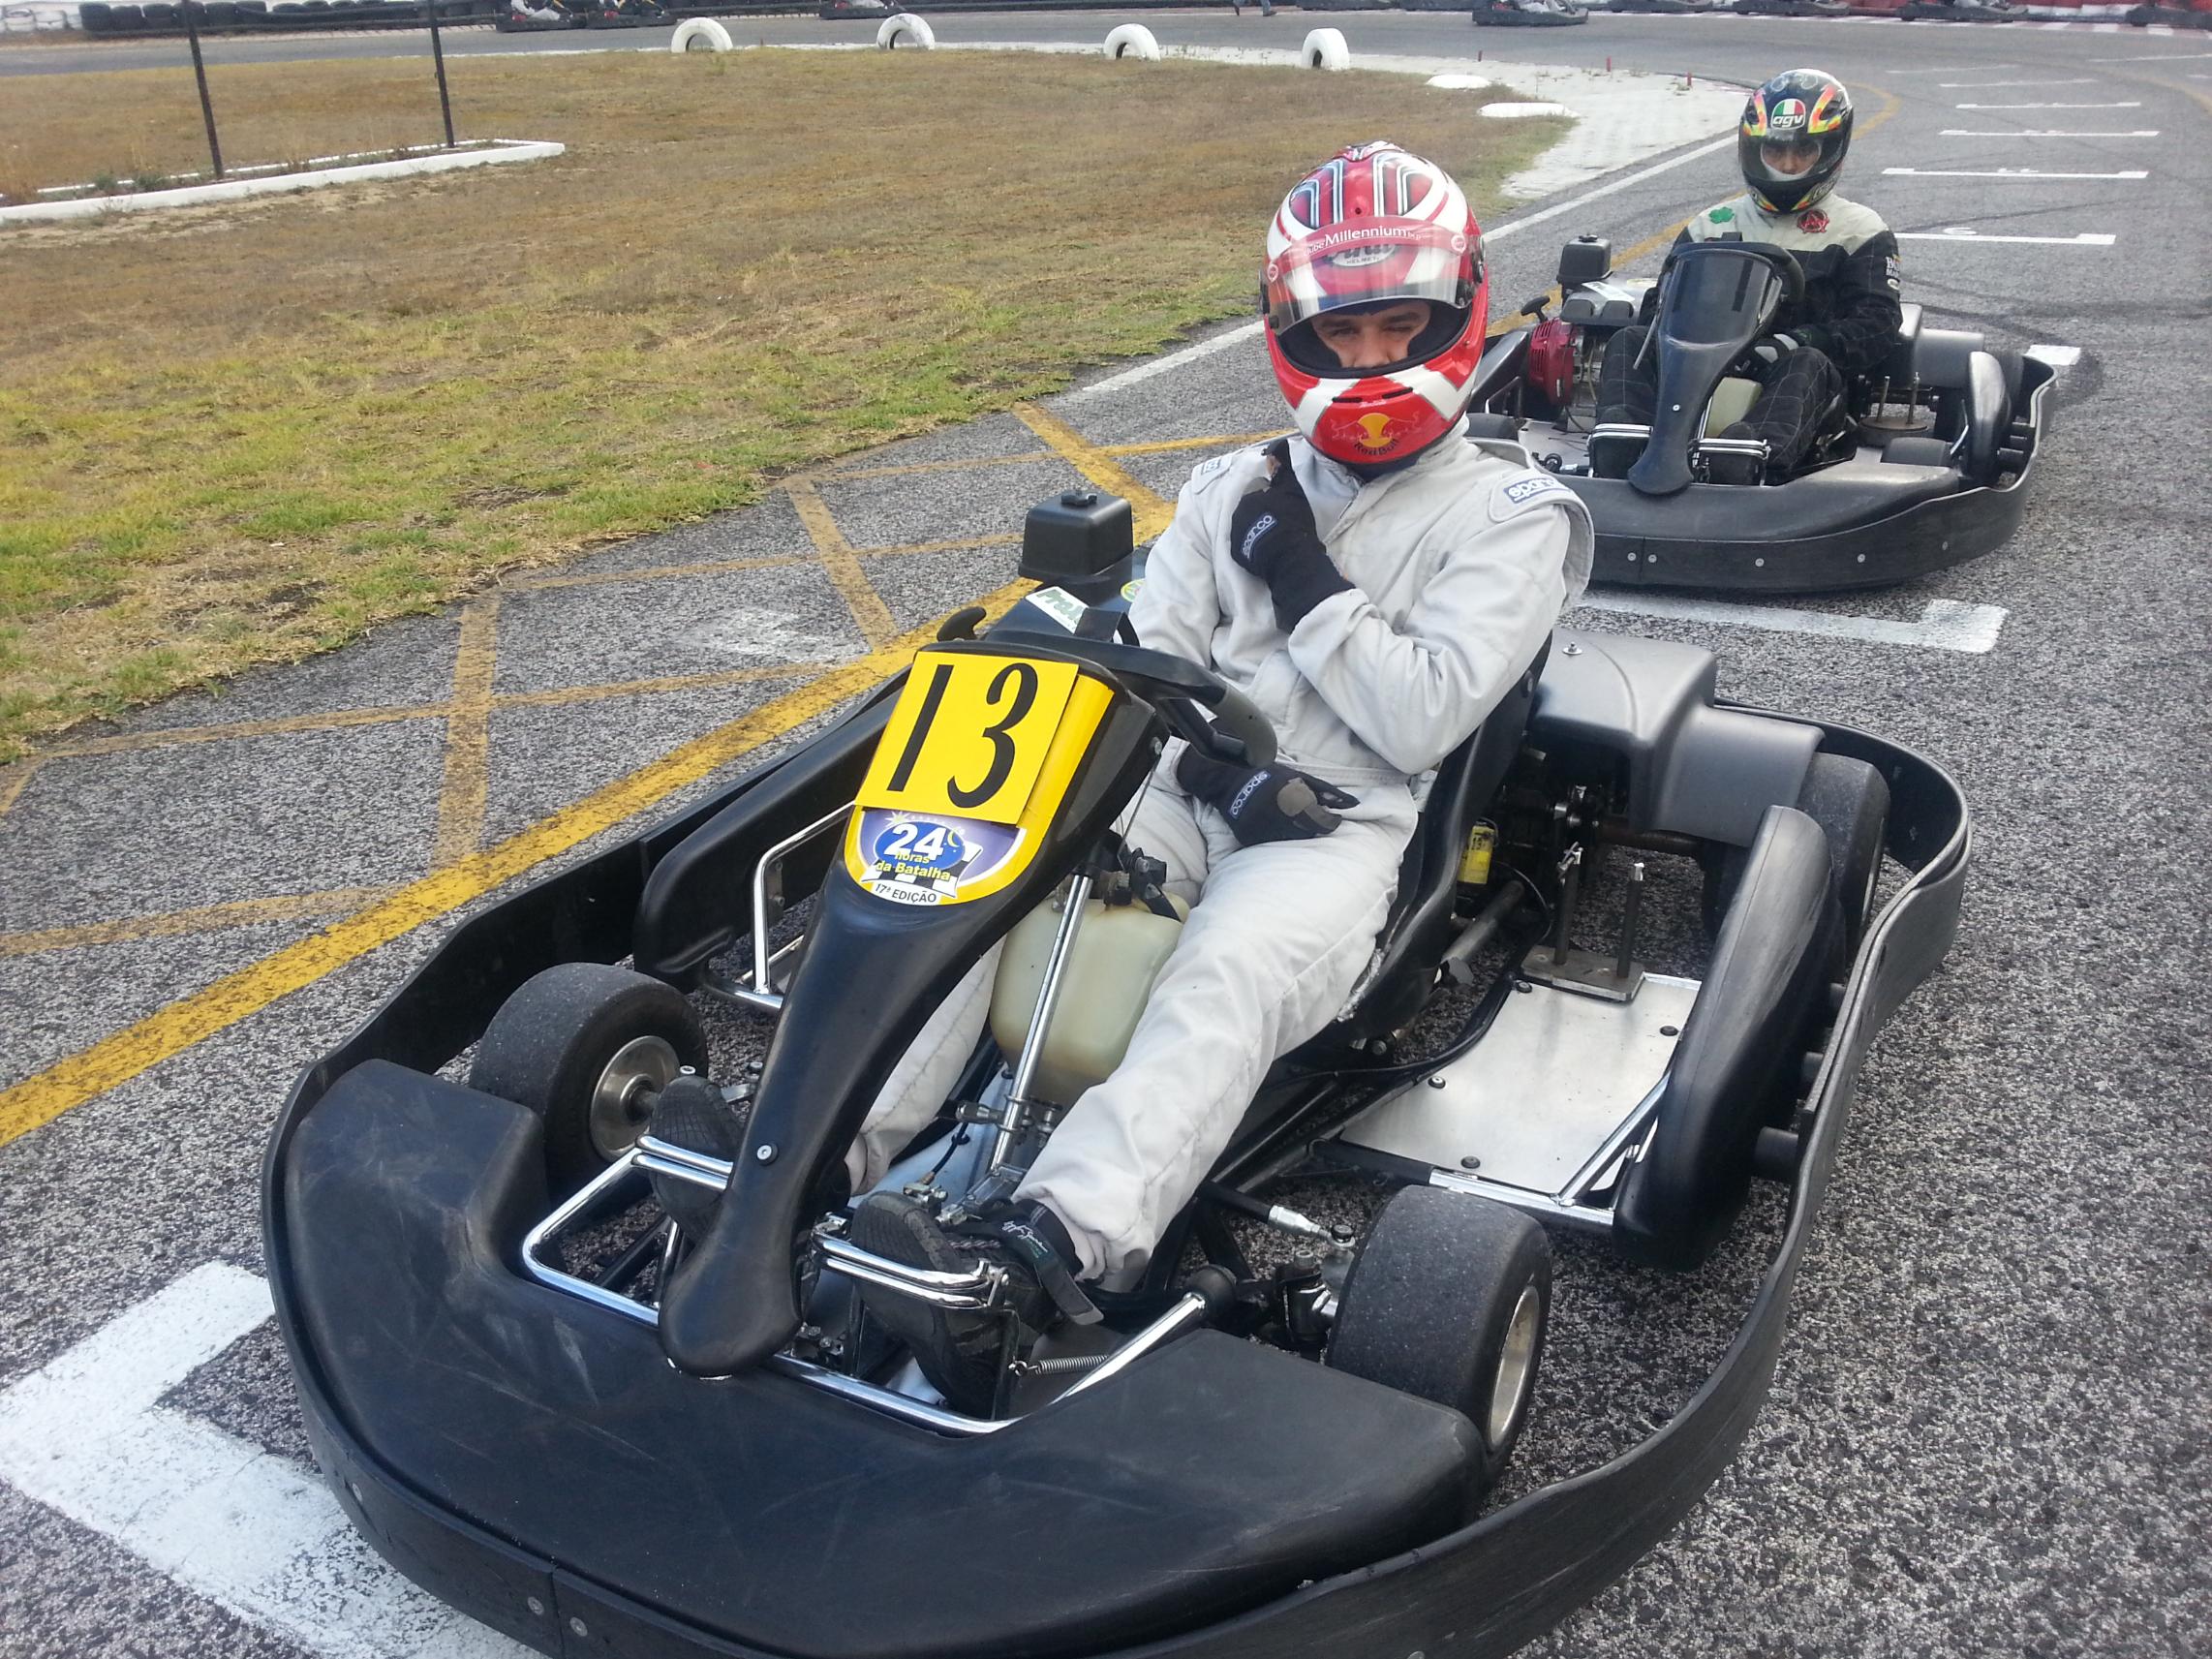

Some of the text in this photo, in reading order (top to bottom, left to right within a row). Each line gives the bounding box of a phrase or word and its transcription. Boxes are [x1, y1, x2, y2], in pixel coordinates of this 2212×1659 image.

[1772, 114, 1803, 128] agv
[1325, 225, 1407, 247] Millennium
[1242, 514, 1274, 556] sparco
[885, 661, 1039, 809] 13
[1231, 772, 1268, 815] sparco
[883, 823, 947, 861] 24
[894, 851, 931, 864] horas
[876, 860, 951, 881] da Batalha
[891, 889, 937, 904] EDIÇÃO
